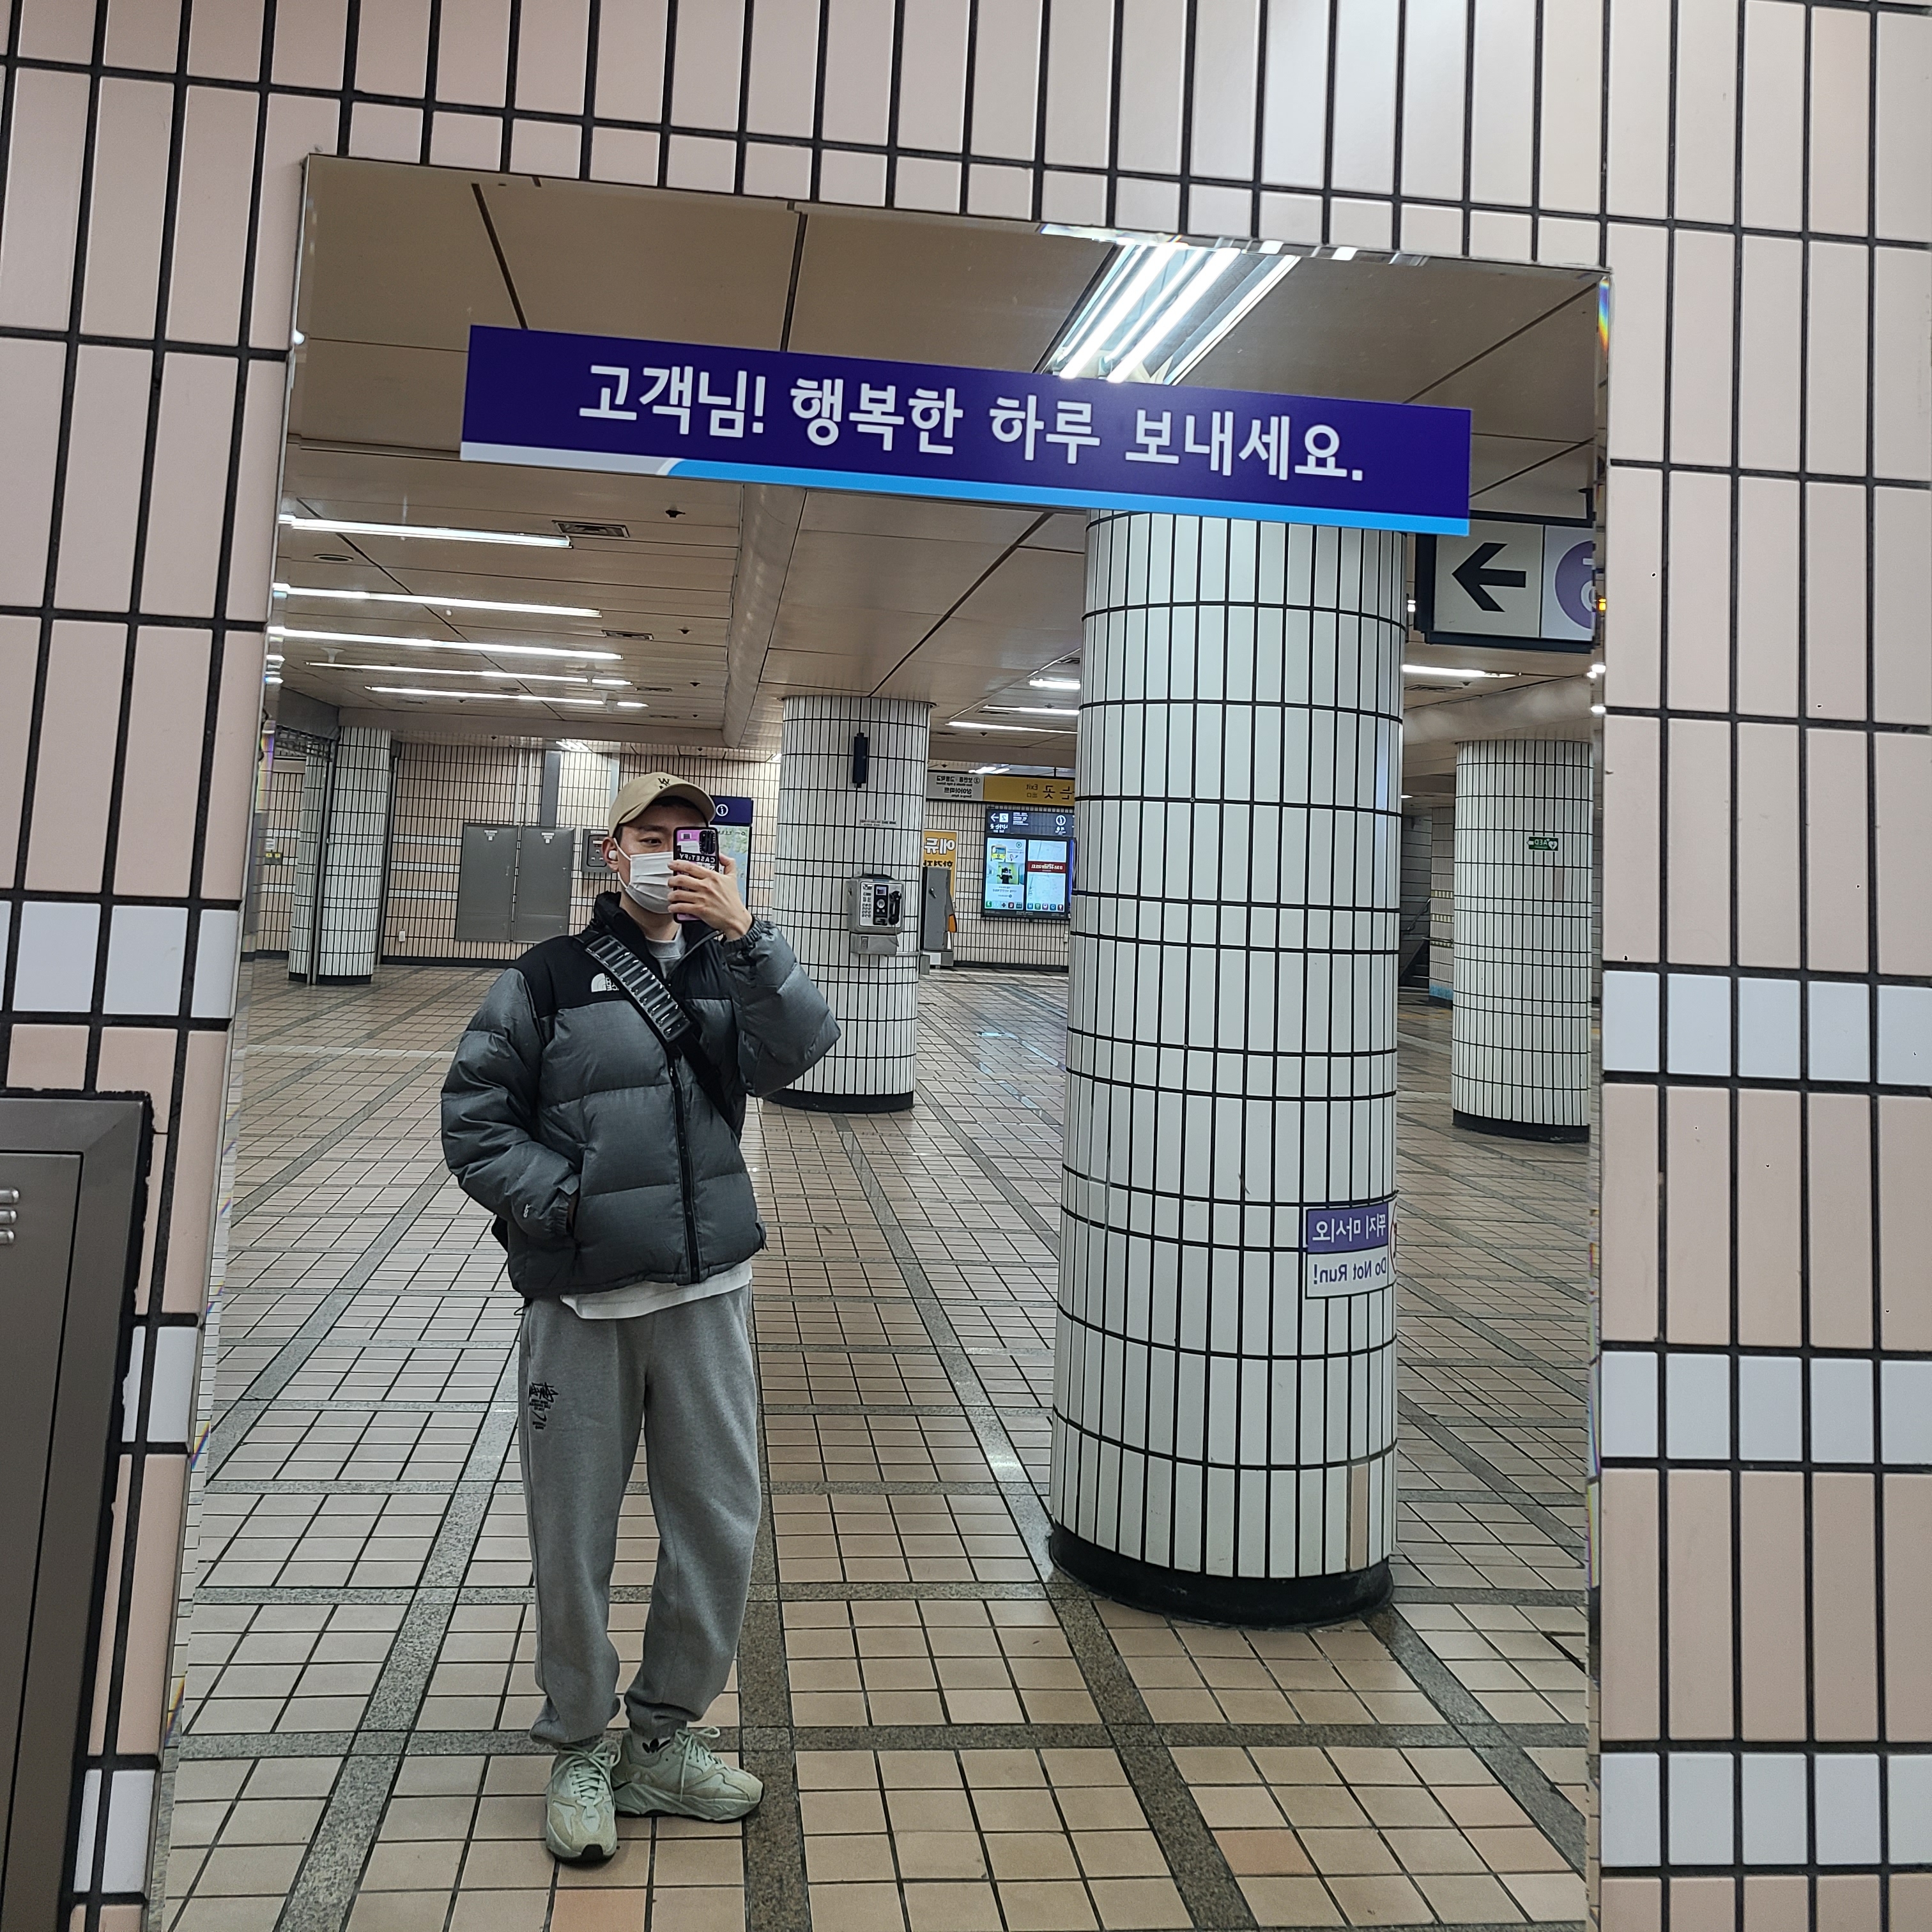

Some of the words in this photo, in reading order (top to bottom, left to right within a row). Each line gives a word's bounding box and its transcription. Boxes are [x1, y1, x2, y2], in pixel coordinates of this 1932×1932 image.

[579, 365, 767, 438] 고객님!
[790, 378, 963, 455] 행복한
[988, 394, 1101, 465] 하루
[1125, 410, 1363, 481] 보내세요.
